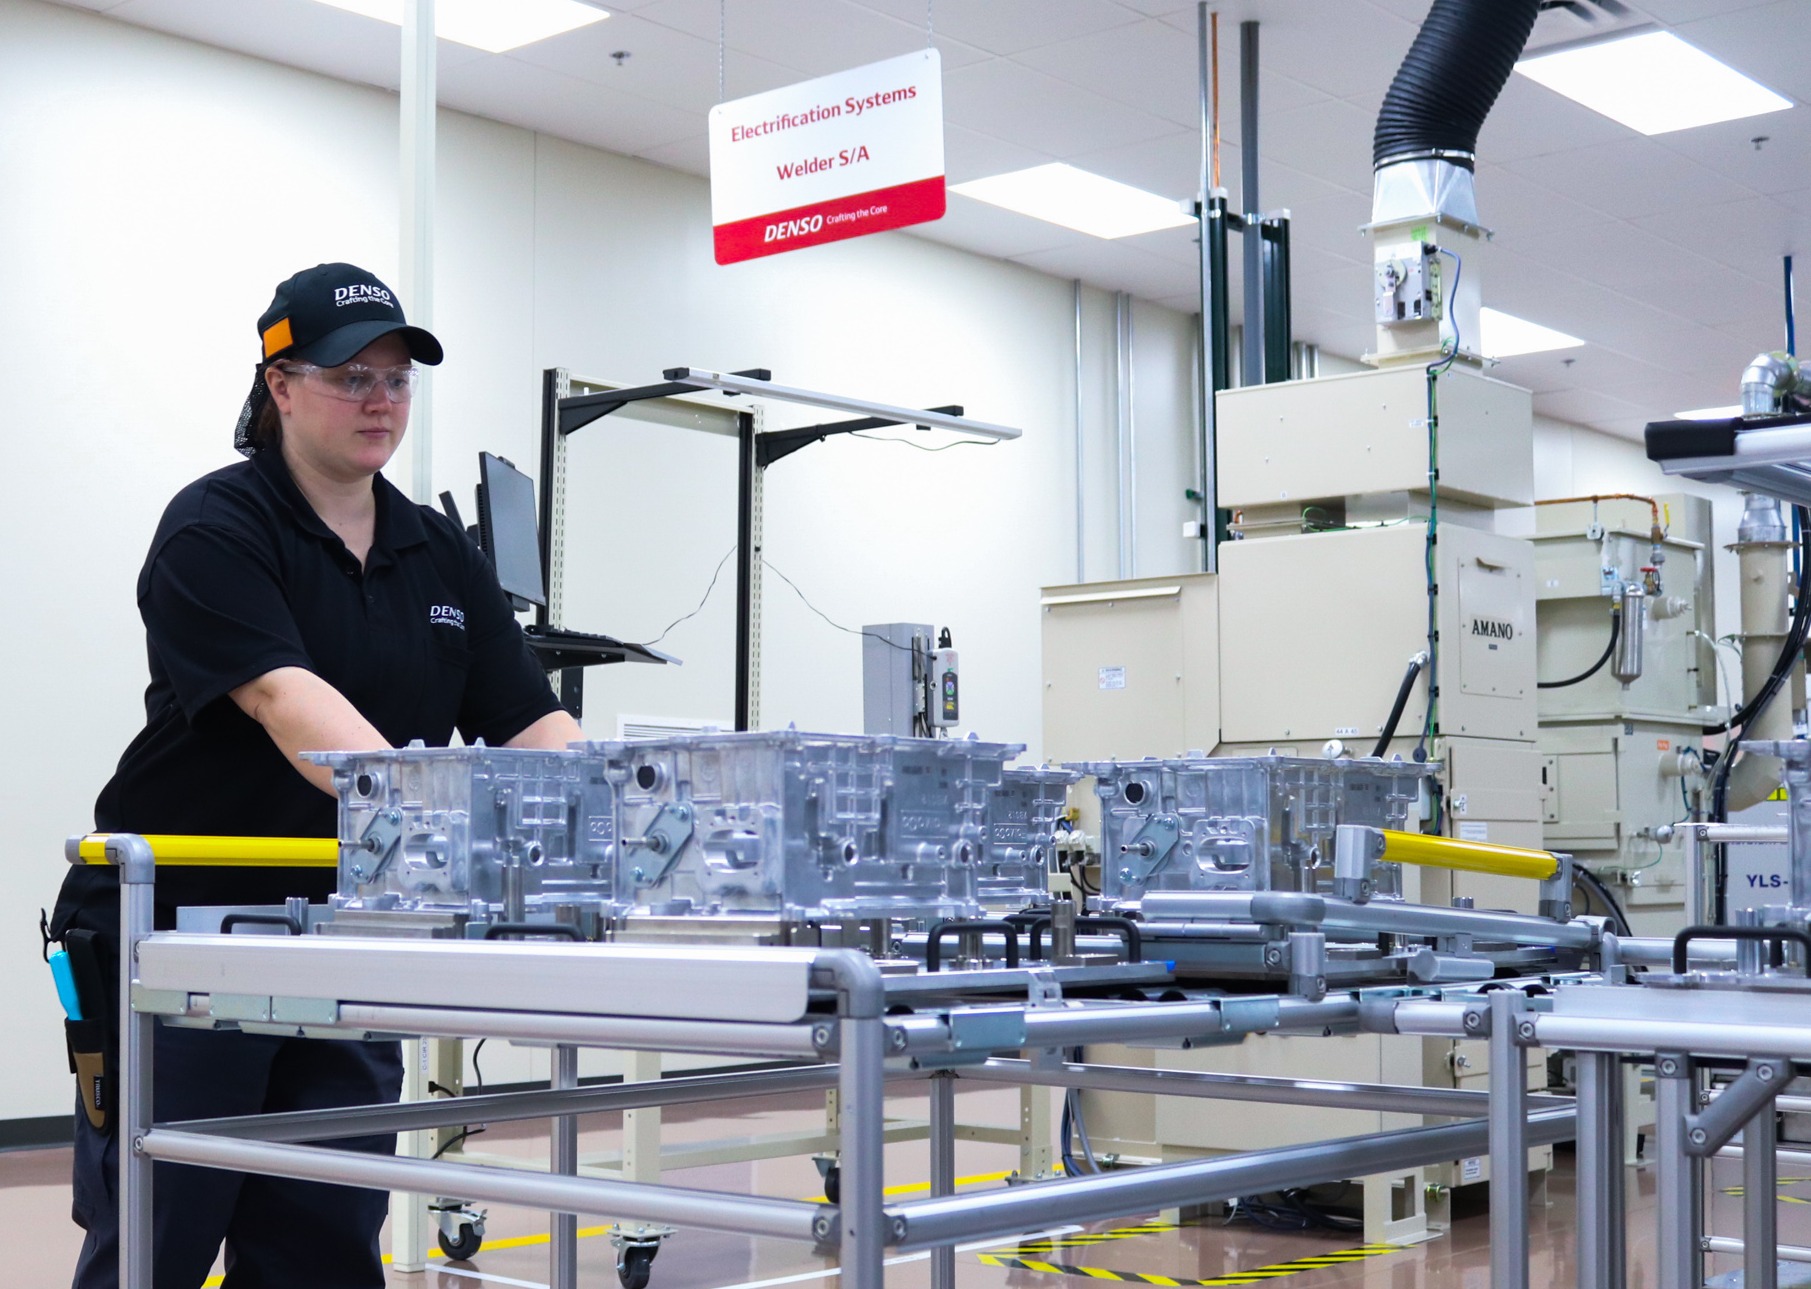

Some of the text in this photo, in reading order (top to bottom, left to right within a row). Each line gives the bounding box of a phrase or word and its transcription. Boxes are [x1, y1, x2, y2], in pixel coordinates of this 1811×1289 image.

[731, 85, 917, 143] Electrification Systems
[776, 145, 870, 181] Welder S/A
[763, 205, 888, 243] DENSO Crafting the Core
[334, 284, 391, 301] DENSO
[336, 295, 369, 307] Crafting
[429, 605, 465, 623] DENSO
[1471, 619, 1514, 641] AMANO
